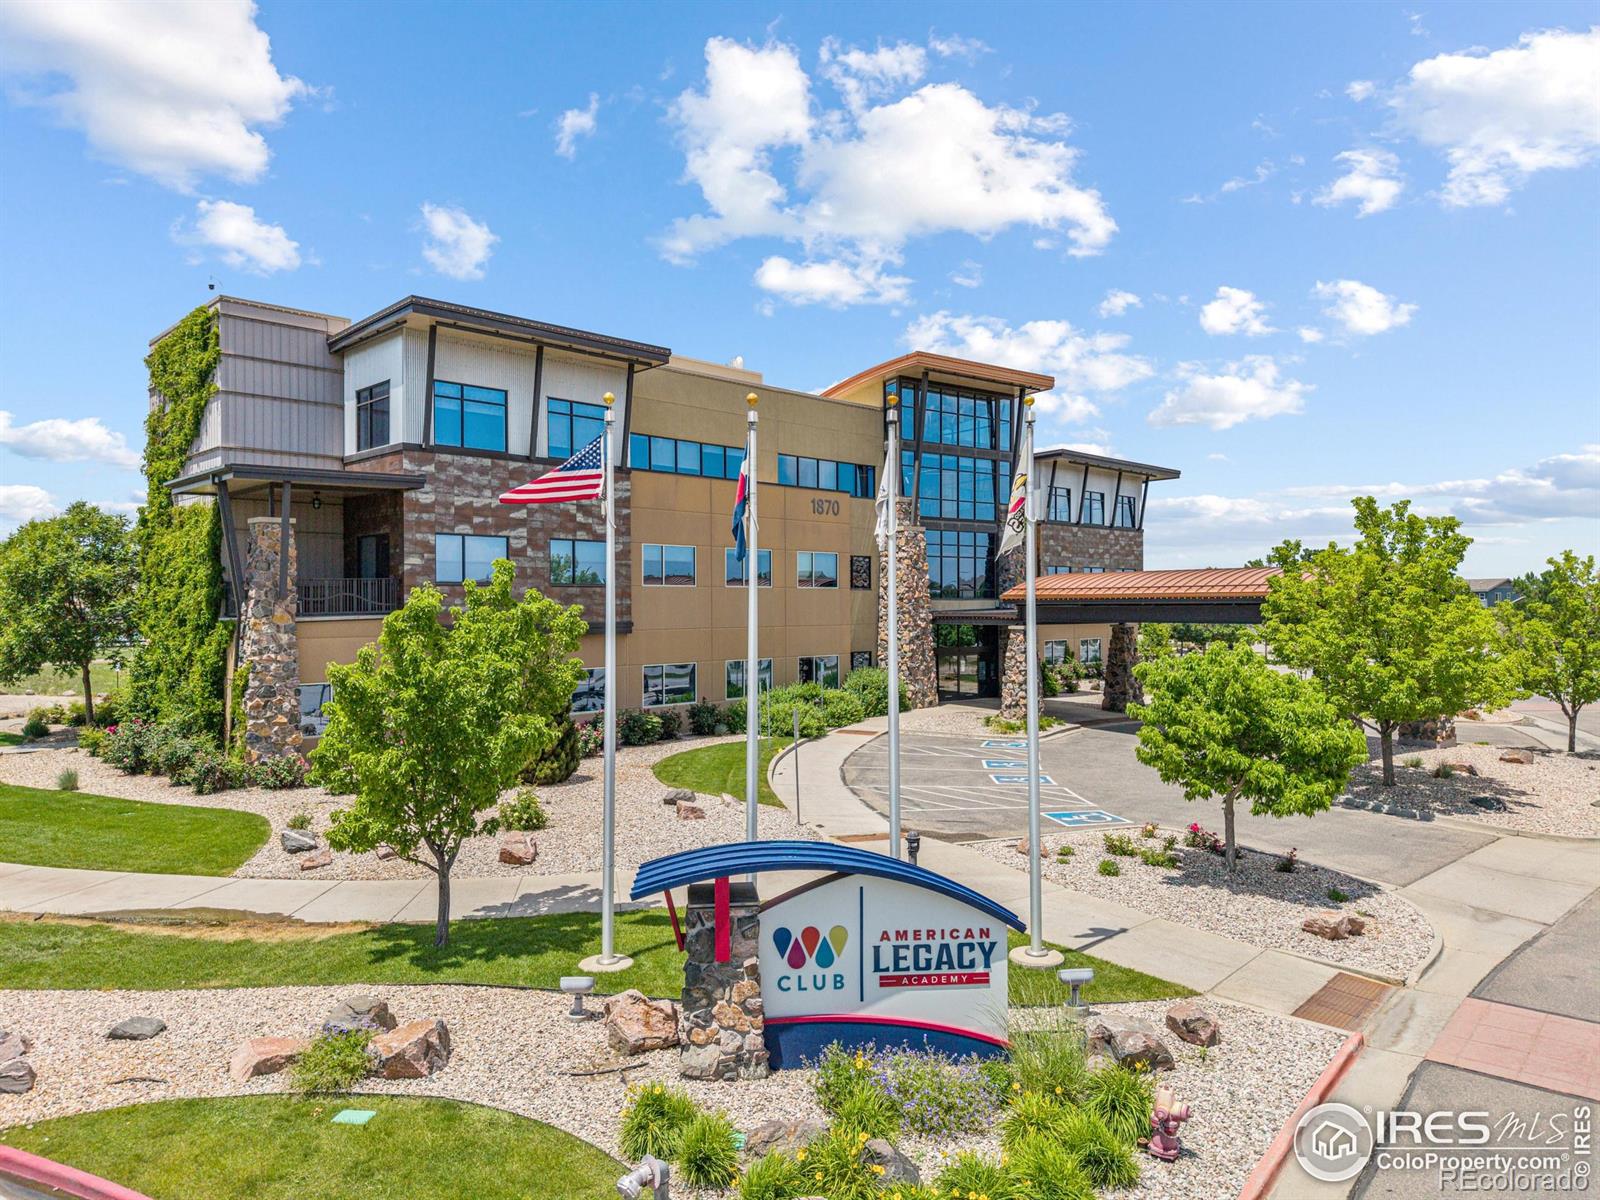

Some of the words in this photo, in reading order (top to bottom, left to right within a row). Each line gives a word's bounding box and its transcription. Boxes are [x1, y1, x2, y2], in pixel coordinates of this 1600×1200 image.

[810, 497, 840, 517] 1870
[879, 927, 991, 942] AMERICAN
[872, 941, 998, 973] LEGACY
[777, 973, 845, 992] CLUB
[901, 975, 968, 985] ACADEMY
